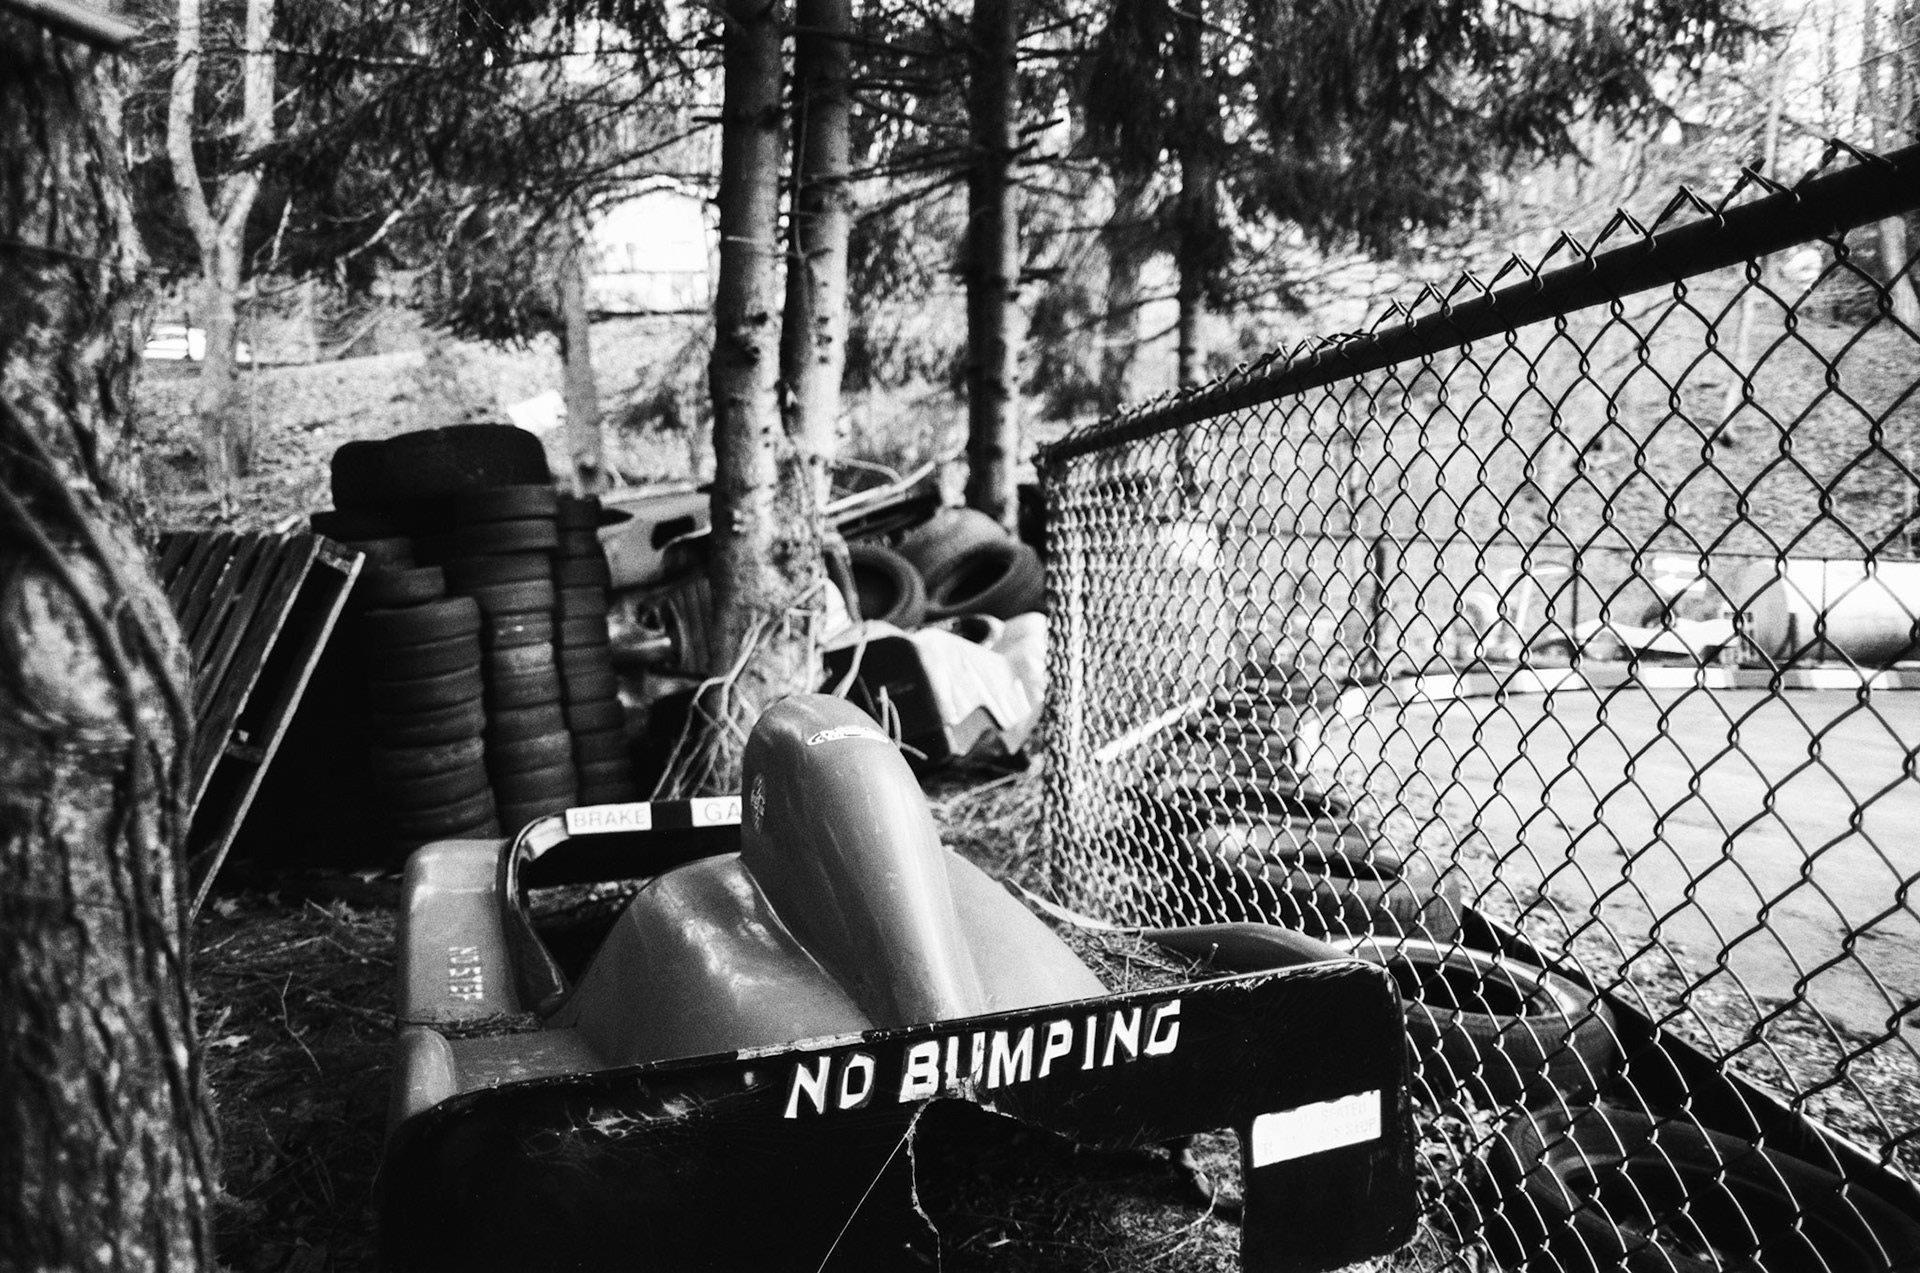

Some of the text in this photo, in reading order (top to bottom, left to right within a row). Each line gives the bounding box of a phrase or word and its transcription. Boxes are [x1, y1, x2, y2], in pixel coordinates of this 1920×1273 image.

[573, 809, 648, 828] BRAKE
[704, 801, 741, 823] GA
[784, 999, 1181, 1119] NO BUMPING
